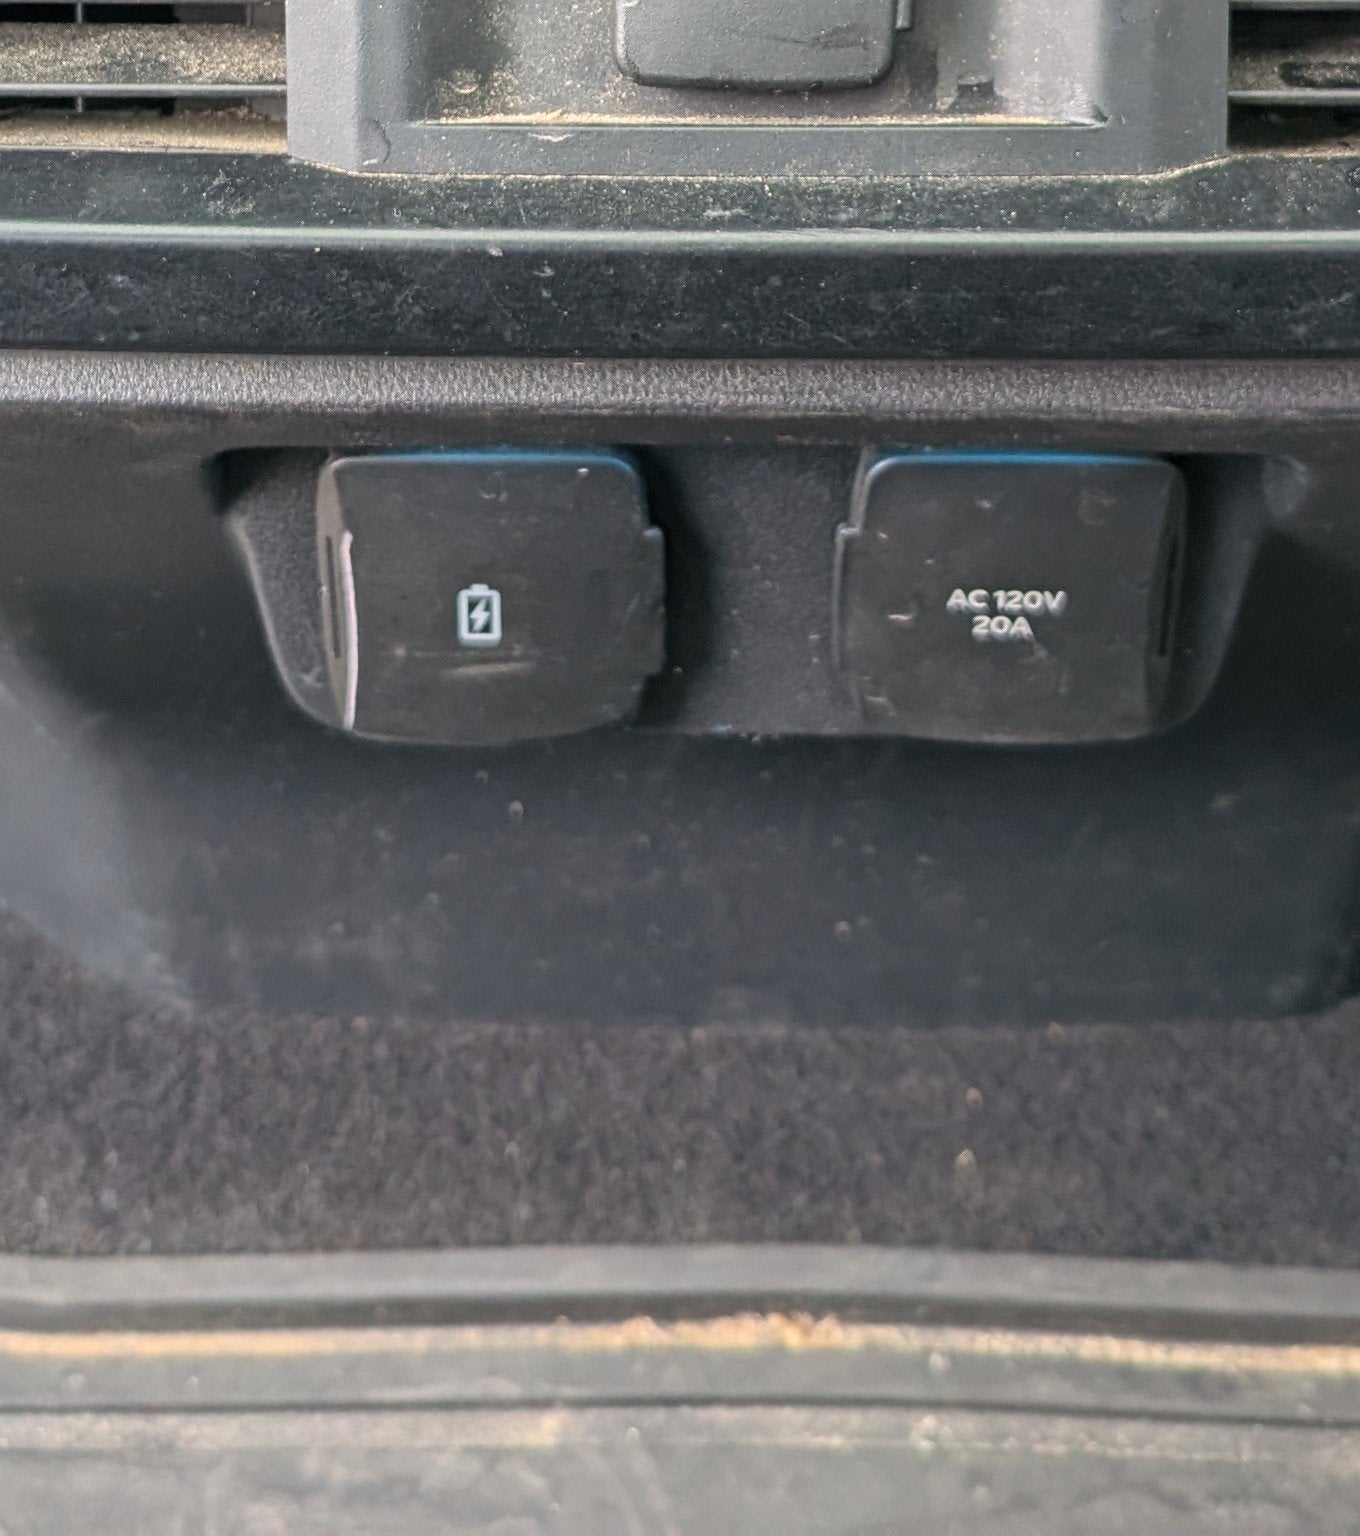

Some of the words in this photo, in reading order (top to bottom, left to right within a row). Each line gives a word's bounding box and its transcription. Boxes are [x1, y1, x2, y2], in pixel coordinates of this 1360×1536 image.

[946, 588, 990, 613] AC
[993, 589, 1067, 615] 120V
[971, 615, 1034, 642] 20A
